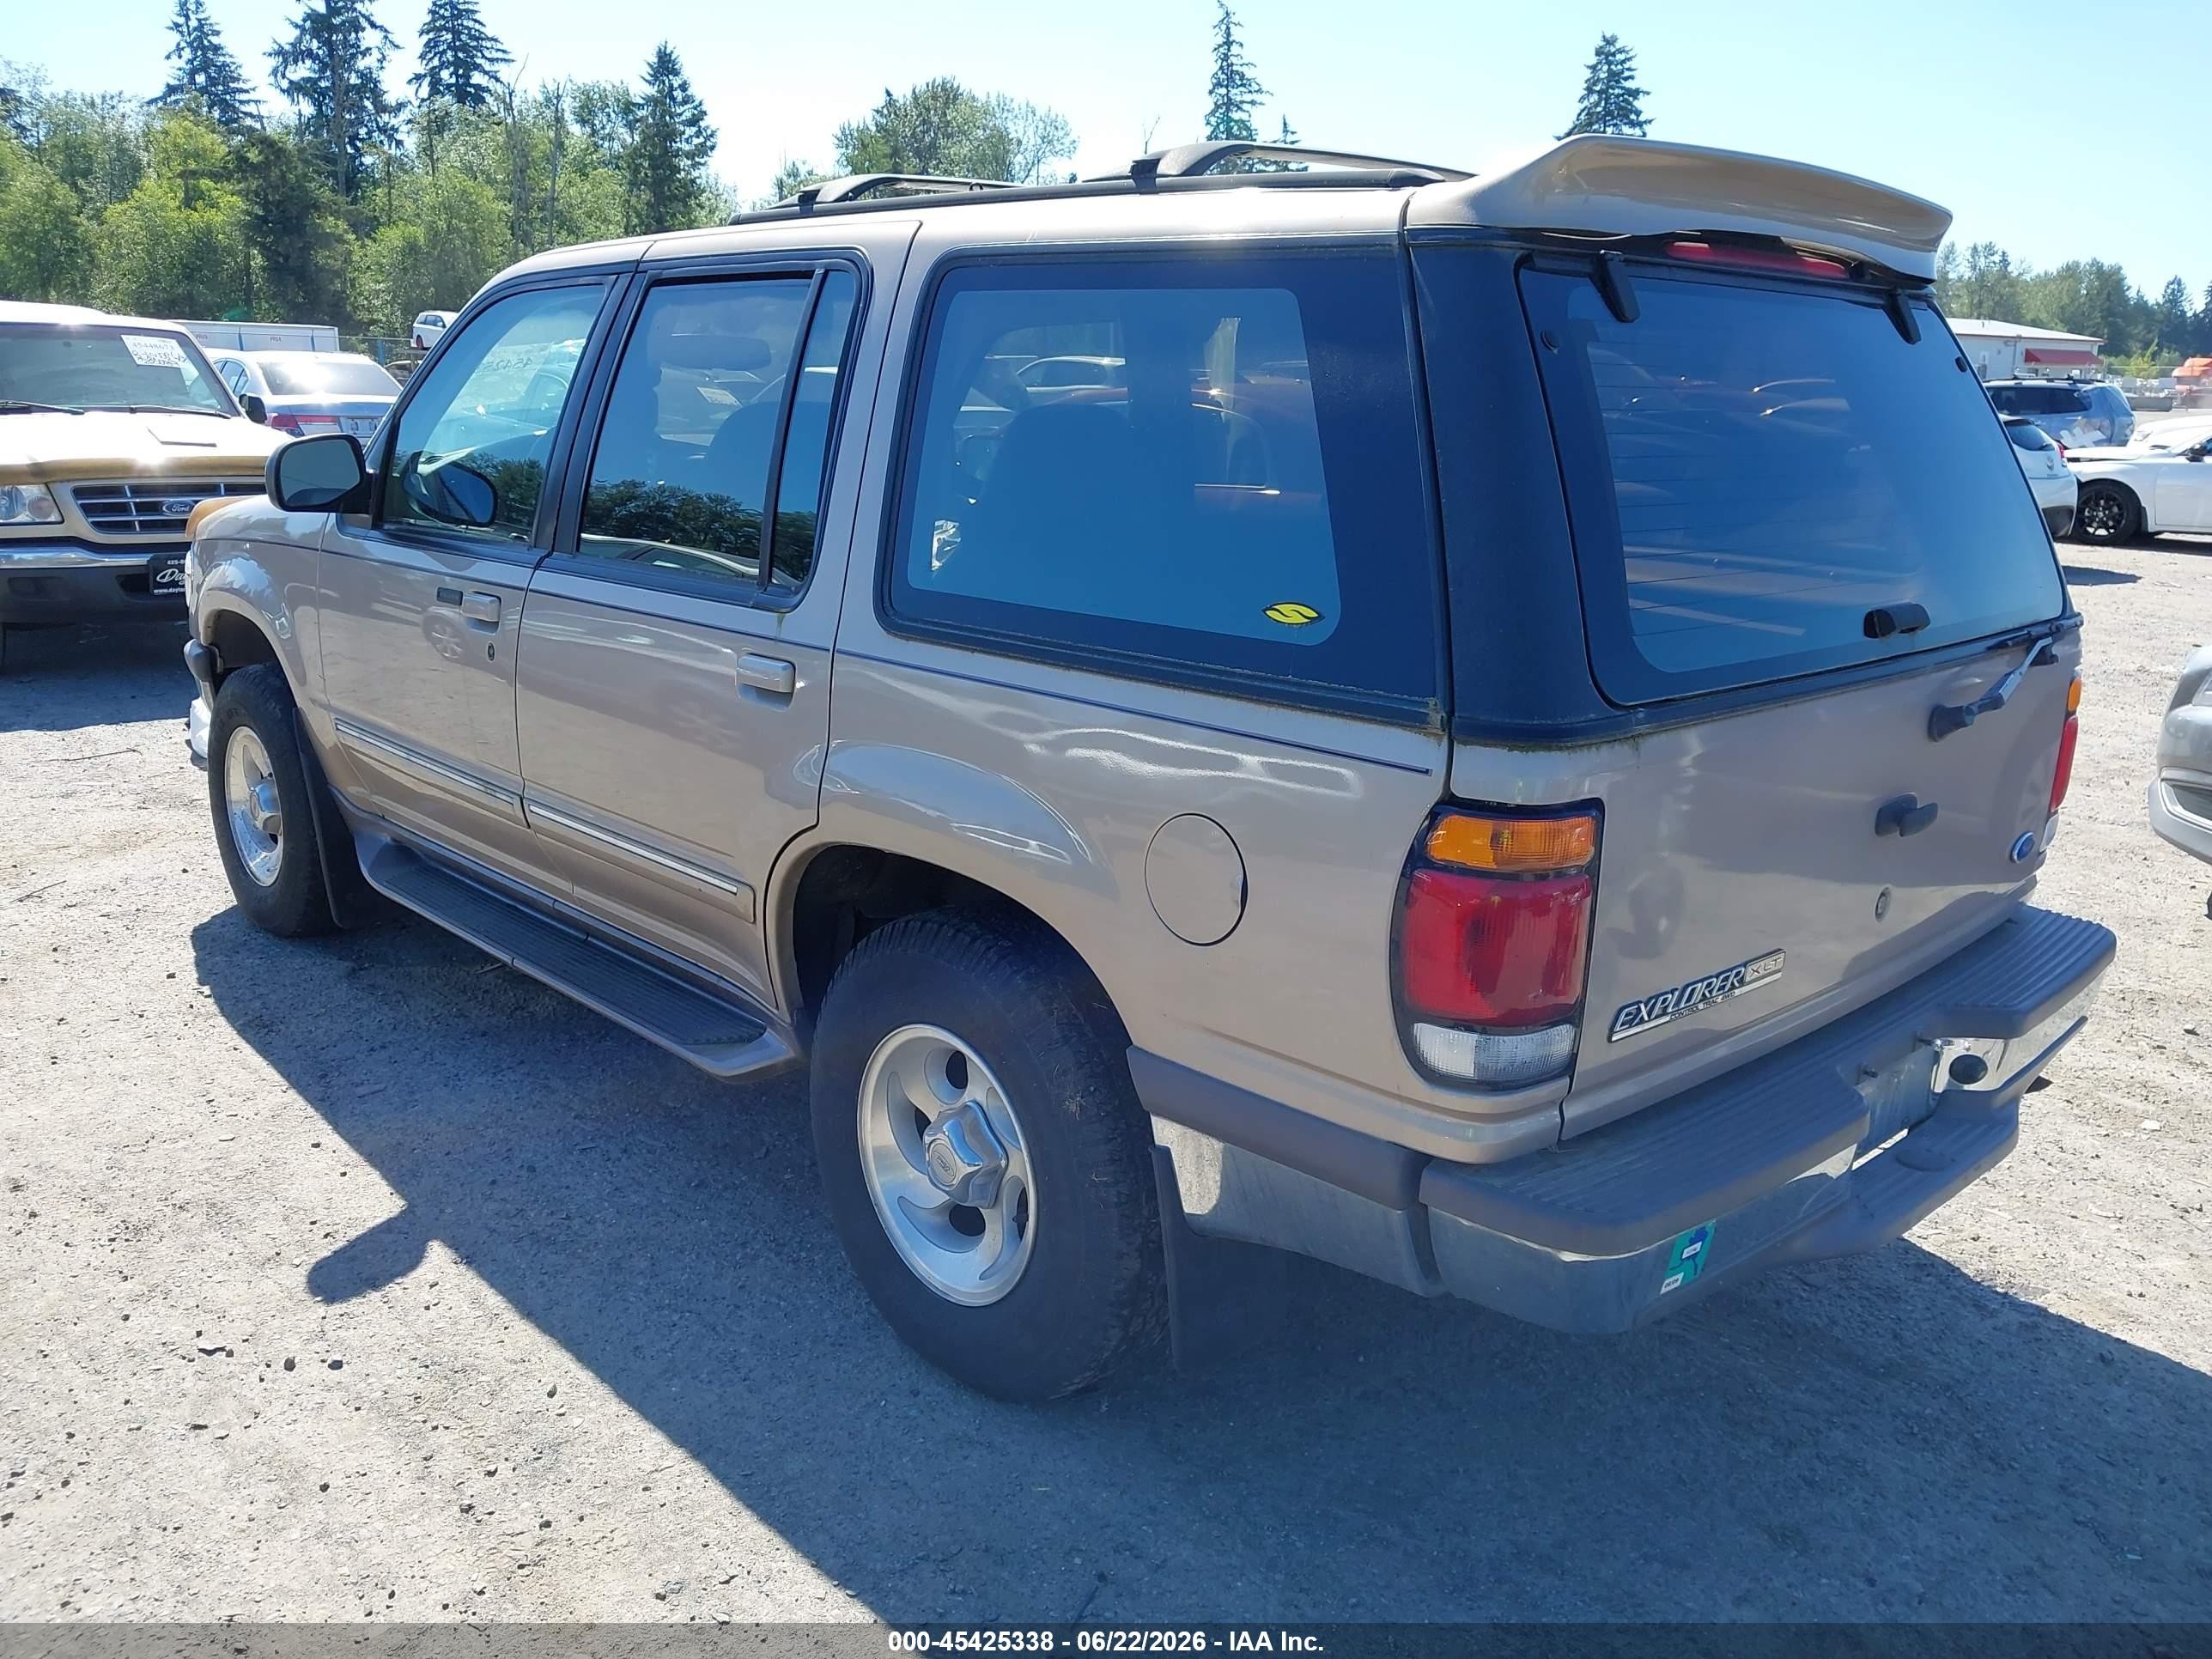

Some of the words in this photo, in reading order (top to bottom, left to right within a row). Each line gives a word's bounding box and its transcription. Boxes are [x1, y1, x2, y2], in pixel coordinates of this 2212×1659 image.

[171, 504, 190, 513] Ford
[1613, 966, 1745, 1031] EXPLORER
[1748, 957, 1783, 977] XLT
